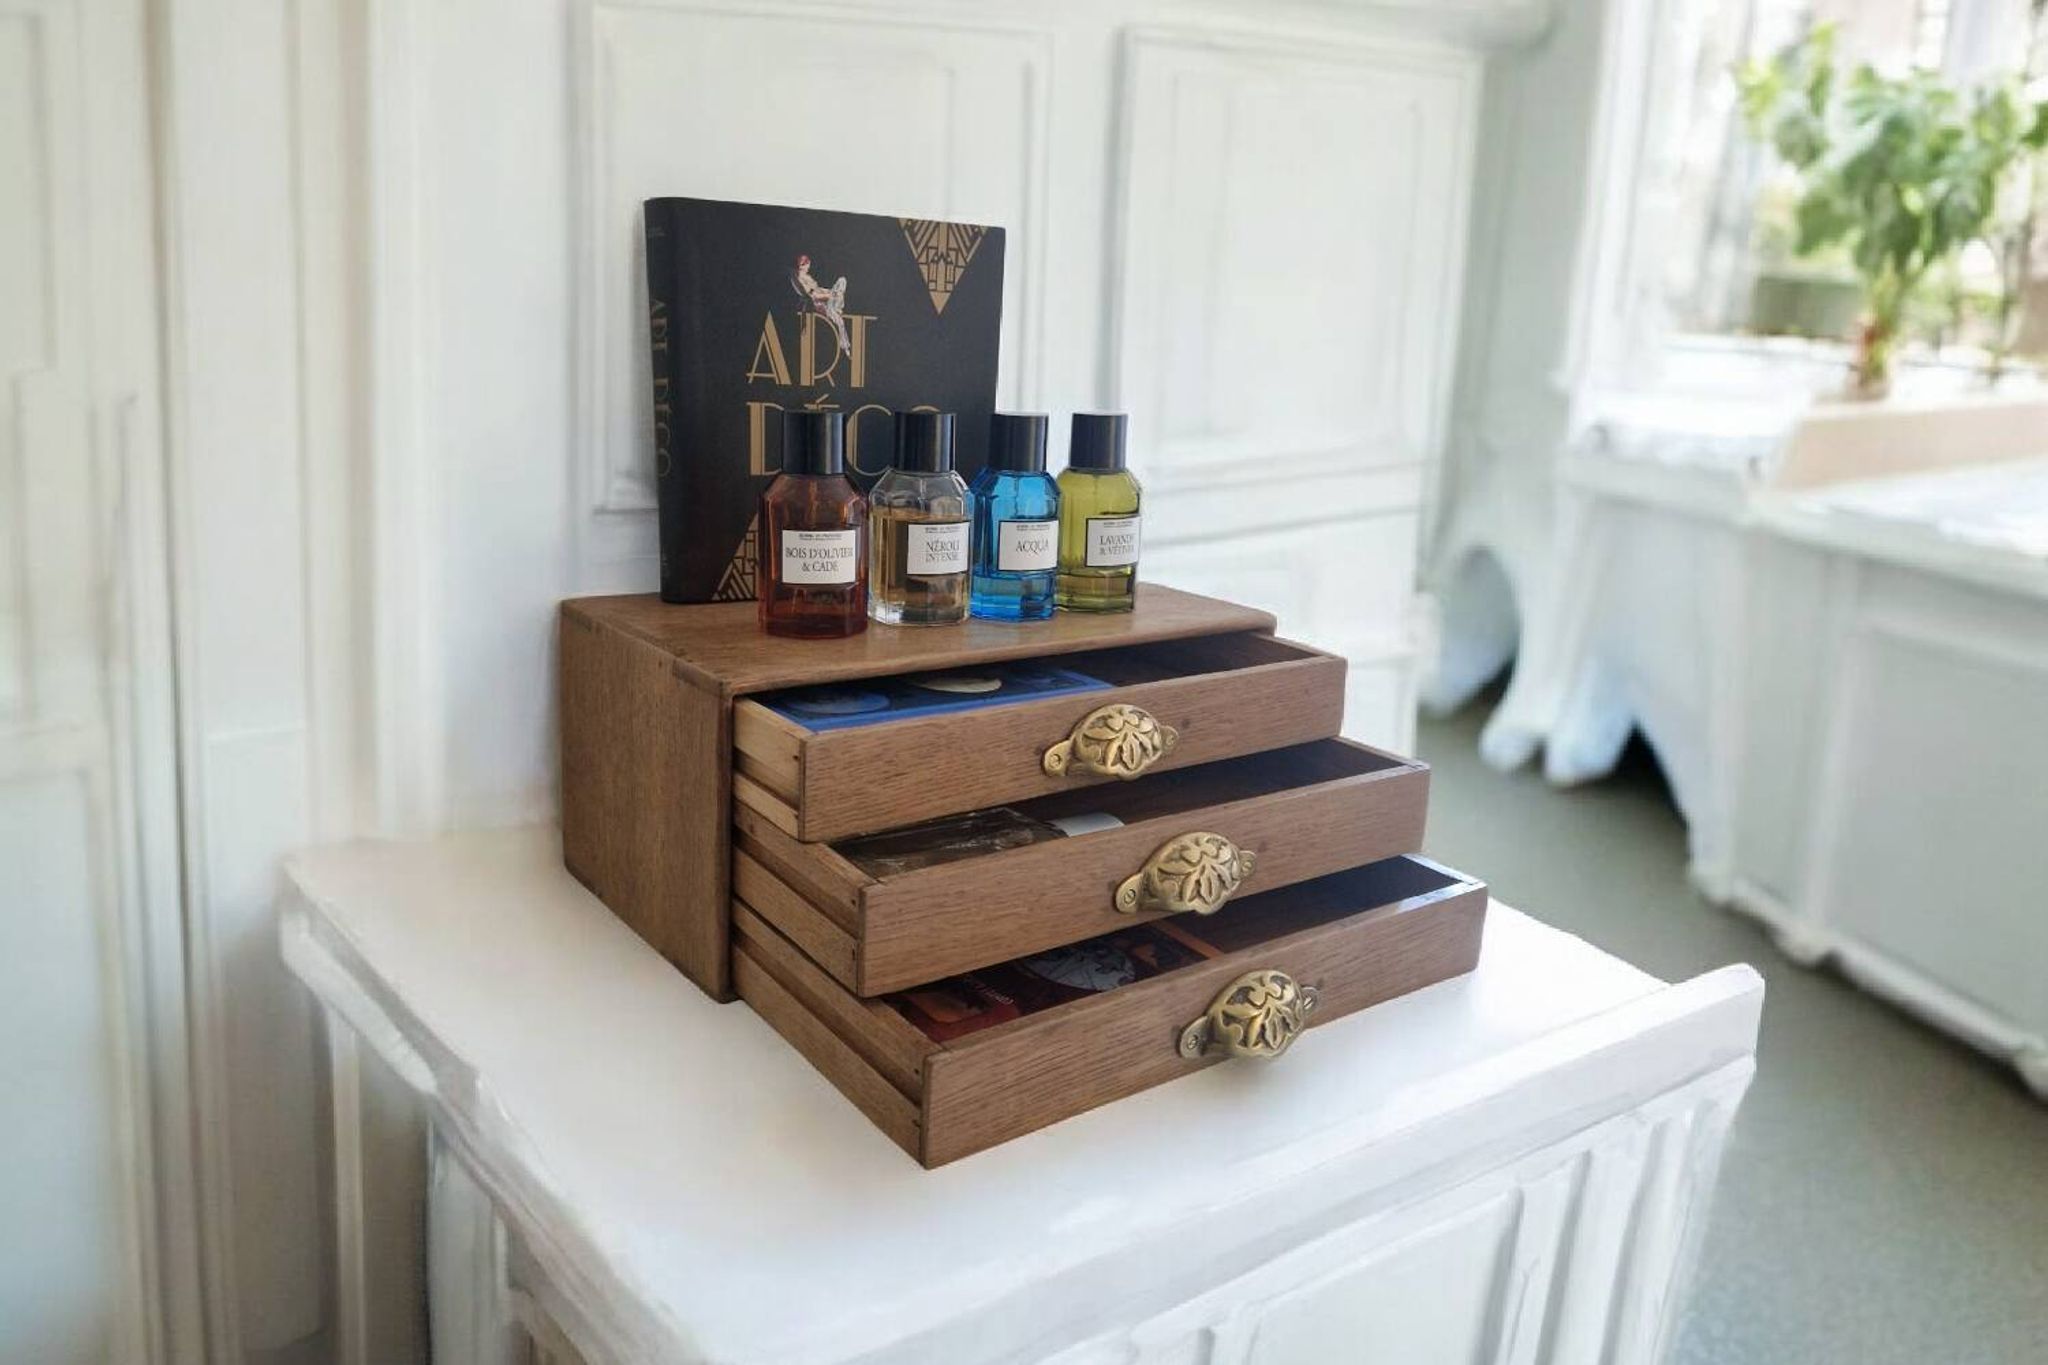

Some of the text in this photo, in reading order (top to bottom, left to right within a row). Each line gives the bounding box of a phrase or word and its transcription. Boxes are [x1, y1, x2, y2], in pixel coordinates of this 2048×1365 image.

[746, 310, 878, 388] ART
[746, 394, 956, 476] DC
[1016, 538, 1050, 555] ACQUA
[1099, 534, 1135, 545] LAVAND
[785, 547, 807, 559] BOIS
[802, 562, 810, 572] &
